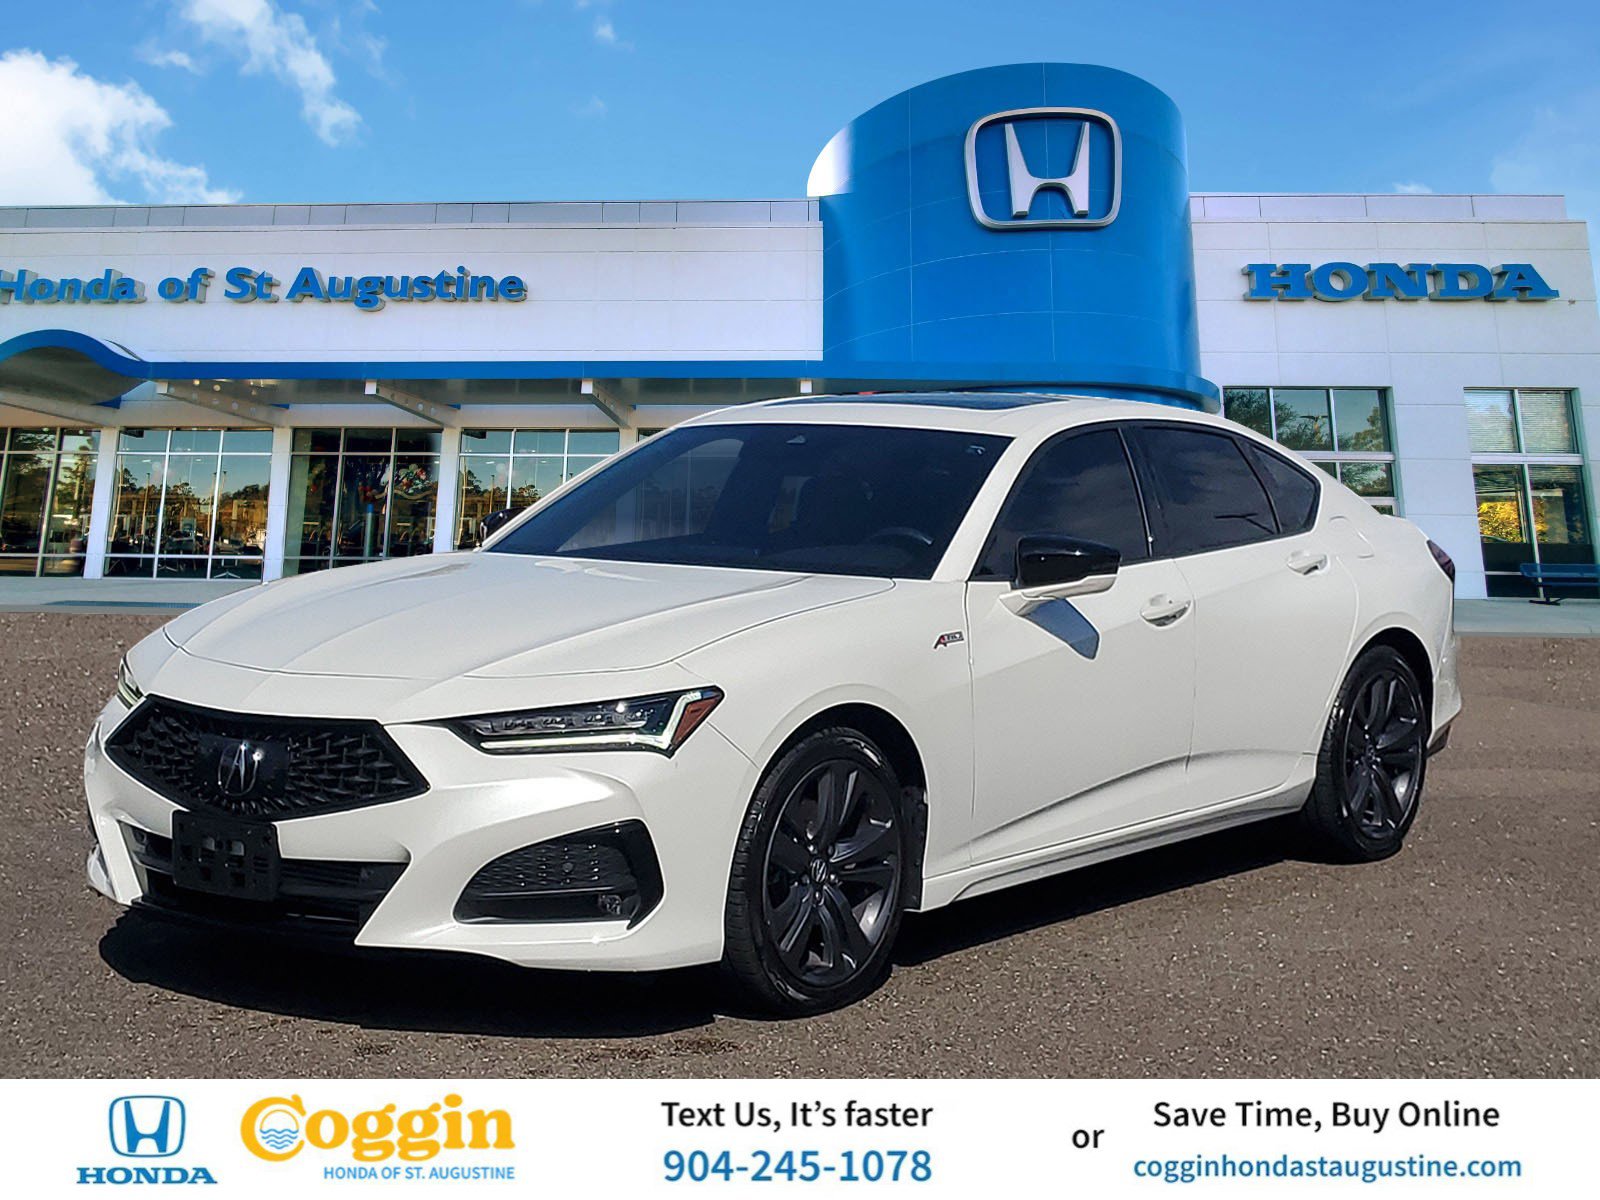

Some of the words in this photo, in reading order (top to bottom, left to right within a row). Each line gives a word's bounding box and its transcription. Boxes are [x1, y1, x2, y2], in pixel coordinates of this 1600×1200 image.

[157, 267, 215, 303] of
[224, 266, 280, 303] St
[285, 265, 528, 312] Augustine
[1242, 261, 1560, 301] HONDA
